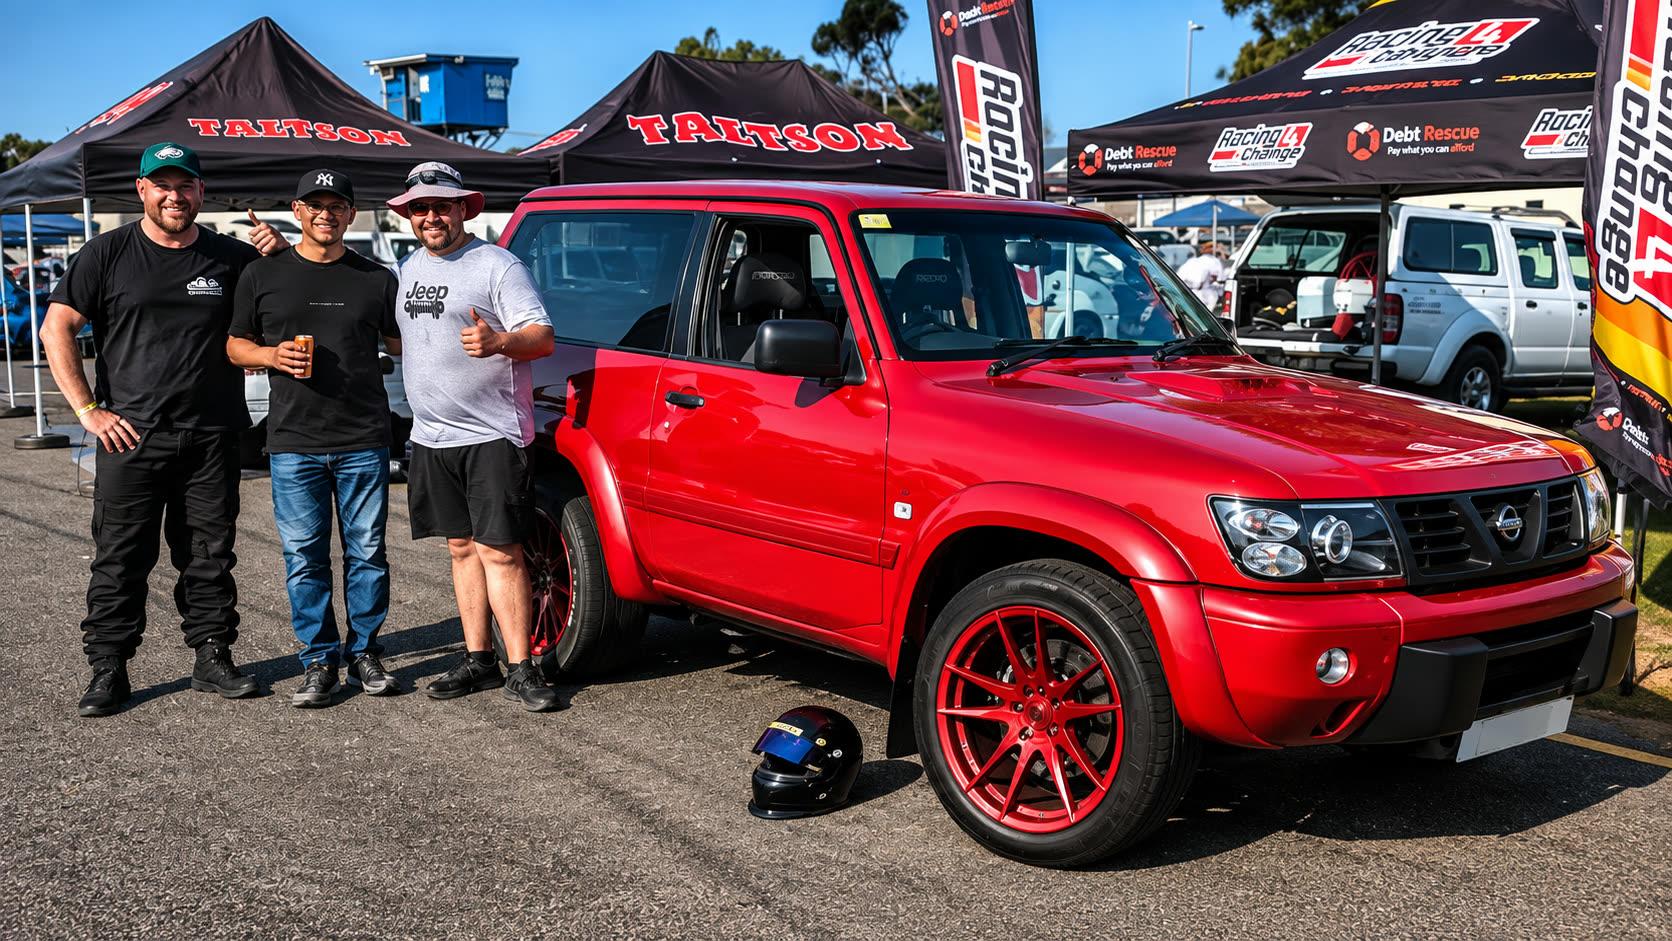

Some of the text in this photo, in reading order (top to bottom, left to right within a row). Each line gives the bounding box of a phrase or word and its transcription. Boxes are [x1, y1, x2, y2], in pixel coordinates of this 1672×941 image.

[187, 118, 411, 147] TALTSON
[627, 111, 914, 153] TALTSON
[1218, 126, 1283, 148] Racing
[1383, 125, 1480, 143] Debt Rescue
[1563, 130, 1590, 147] Ch
[1104, 145, 1177, 161] Debt Rescue
[1603, 87, 1650, 294] Change
[405, 281, 448, 302] Jeep
